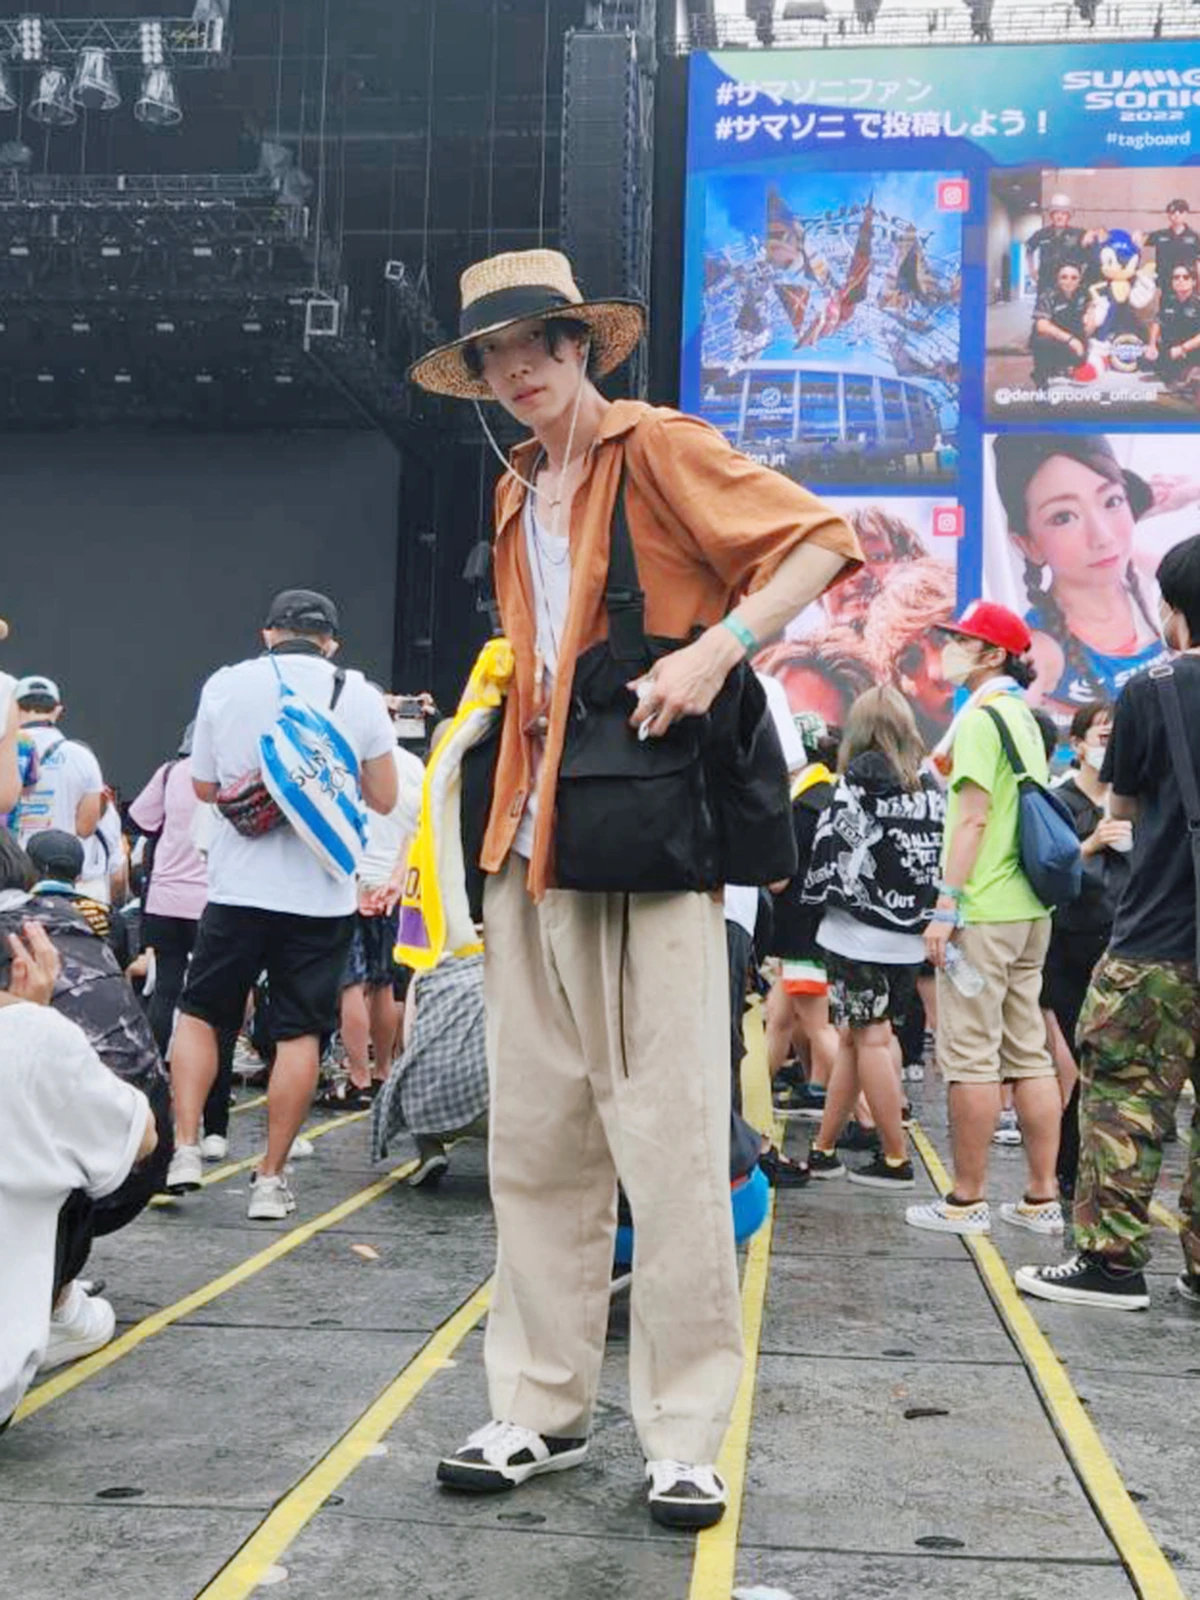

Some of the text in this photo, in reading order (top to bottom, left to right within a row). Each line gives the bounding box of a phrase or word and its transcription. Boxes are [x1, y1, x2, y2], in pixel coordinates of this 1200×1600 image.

[716, 78, 932, 107] #サマソニファン
[1120, 110, 1184, 122] 2022
[715, 112, 846, 142] #サマソニ
[1106, 130, 1191, 151] #tagboard
[994, 387, 1158, 405] @denkigroove_official
